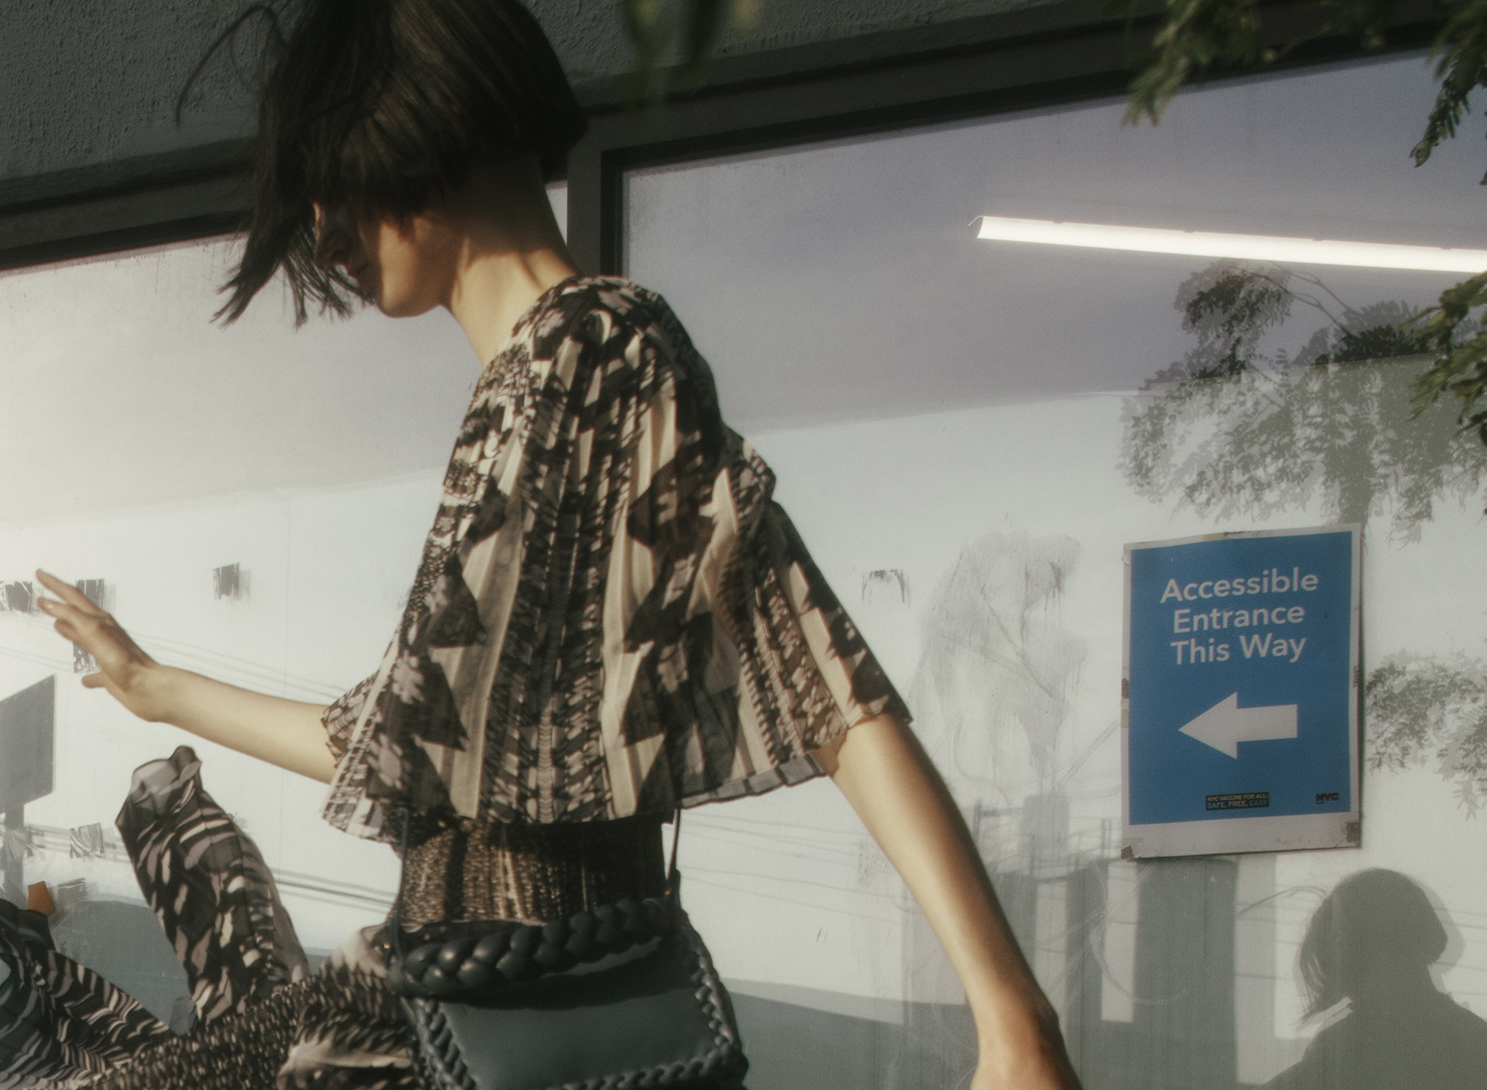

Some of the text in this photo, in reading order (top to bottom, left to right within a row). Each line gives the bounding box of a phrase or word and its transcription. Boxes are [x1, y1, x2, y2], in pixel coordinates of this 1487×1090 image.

[1160, 566, 1319, 603] Accessible
[1173, 606, 1306, 634] Entrance
[1170, 632, 1306, 665] This Way
[1316, 792, 1340, 801] NYC
